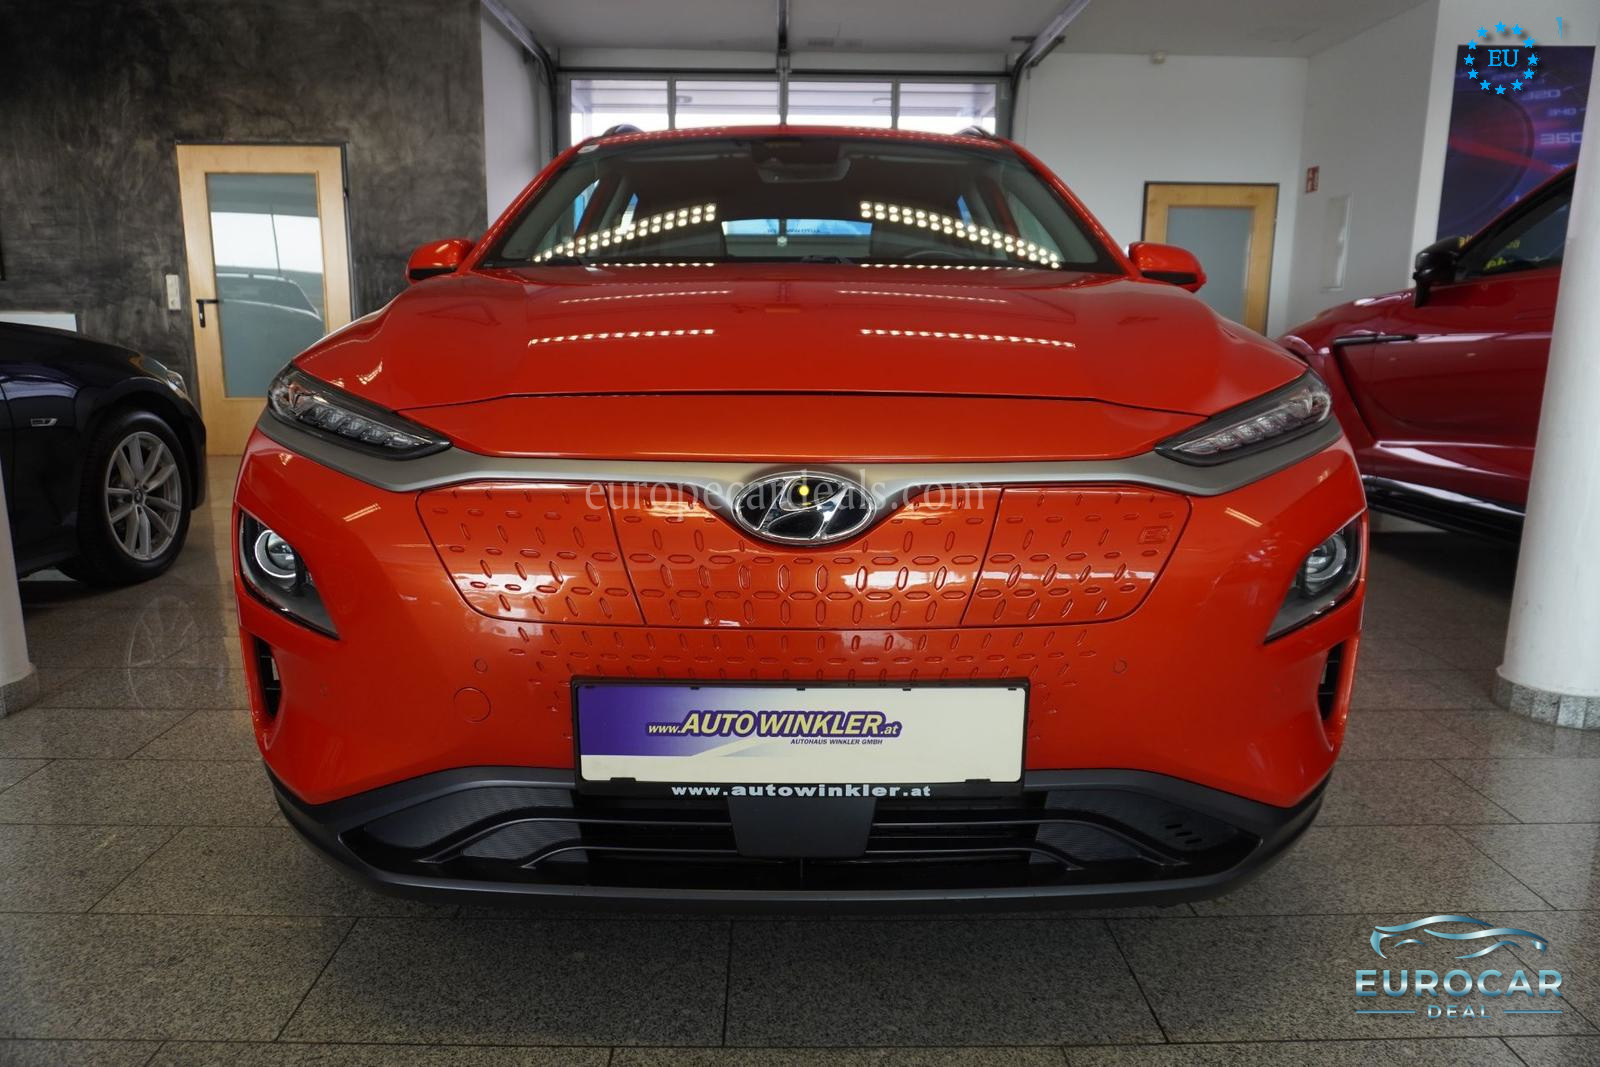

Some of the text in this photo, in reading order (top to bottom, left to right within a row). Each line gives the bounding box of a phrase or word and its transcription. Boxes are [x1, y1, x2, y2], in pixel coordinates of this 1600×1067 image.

[790, 738, 883, 746] AUTOHAUS WINKLER GMBH
[671, 784, 931, 798] www.autowinkler.at
